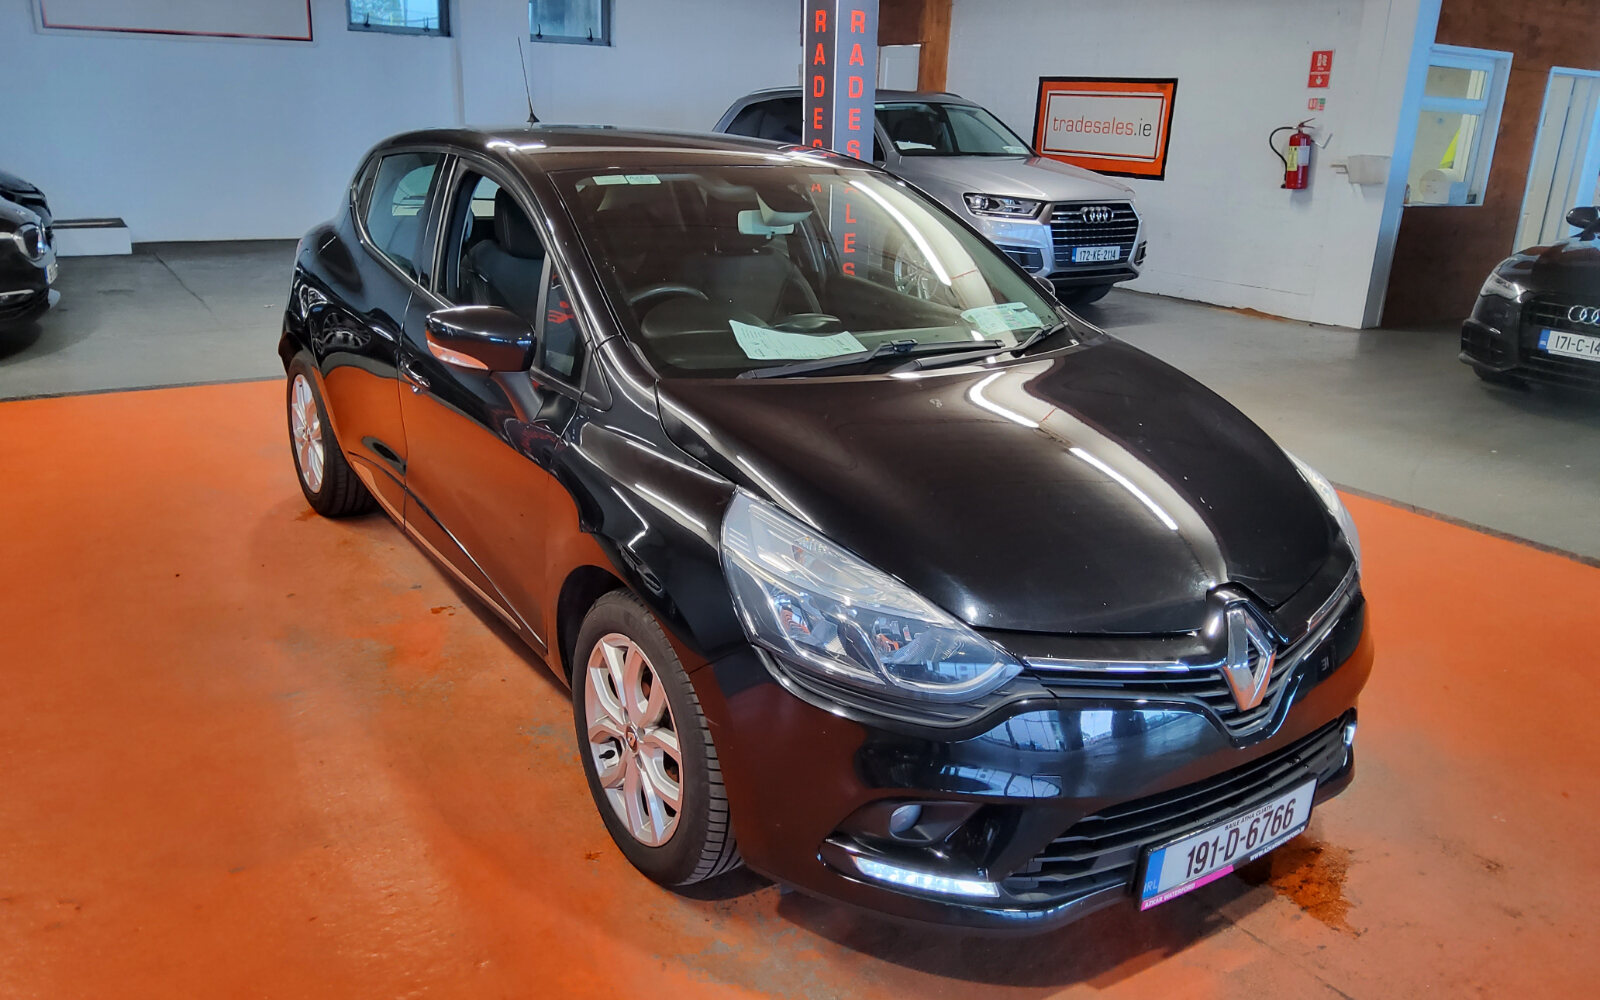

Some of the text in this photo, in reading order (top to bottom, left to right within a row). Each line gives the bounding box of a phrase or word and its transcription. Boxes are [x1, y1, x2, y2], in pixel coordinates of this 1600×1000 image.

[1053, 115, 1152, 137] tradesales.ie
[1080, 250, 1116, 261] 172-KE-2114
[1186, 798, 1296, 879] 191-D-6766
[1144, 879, 1158, 893] IRL
